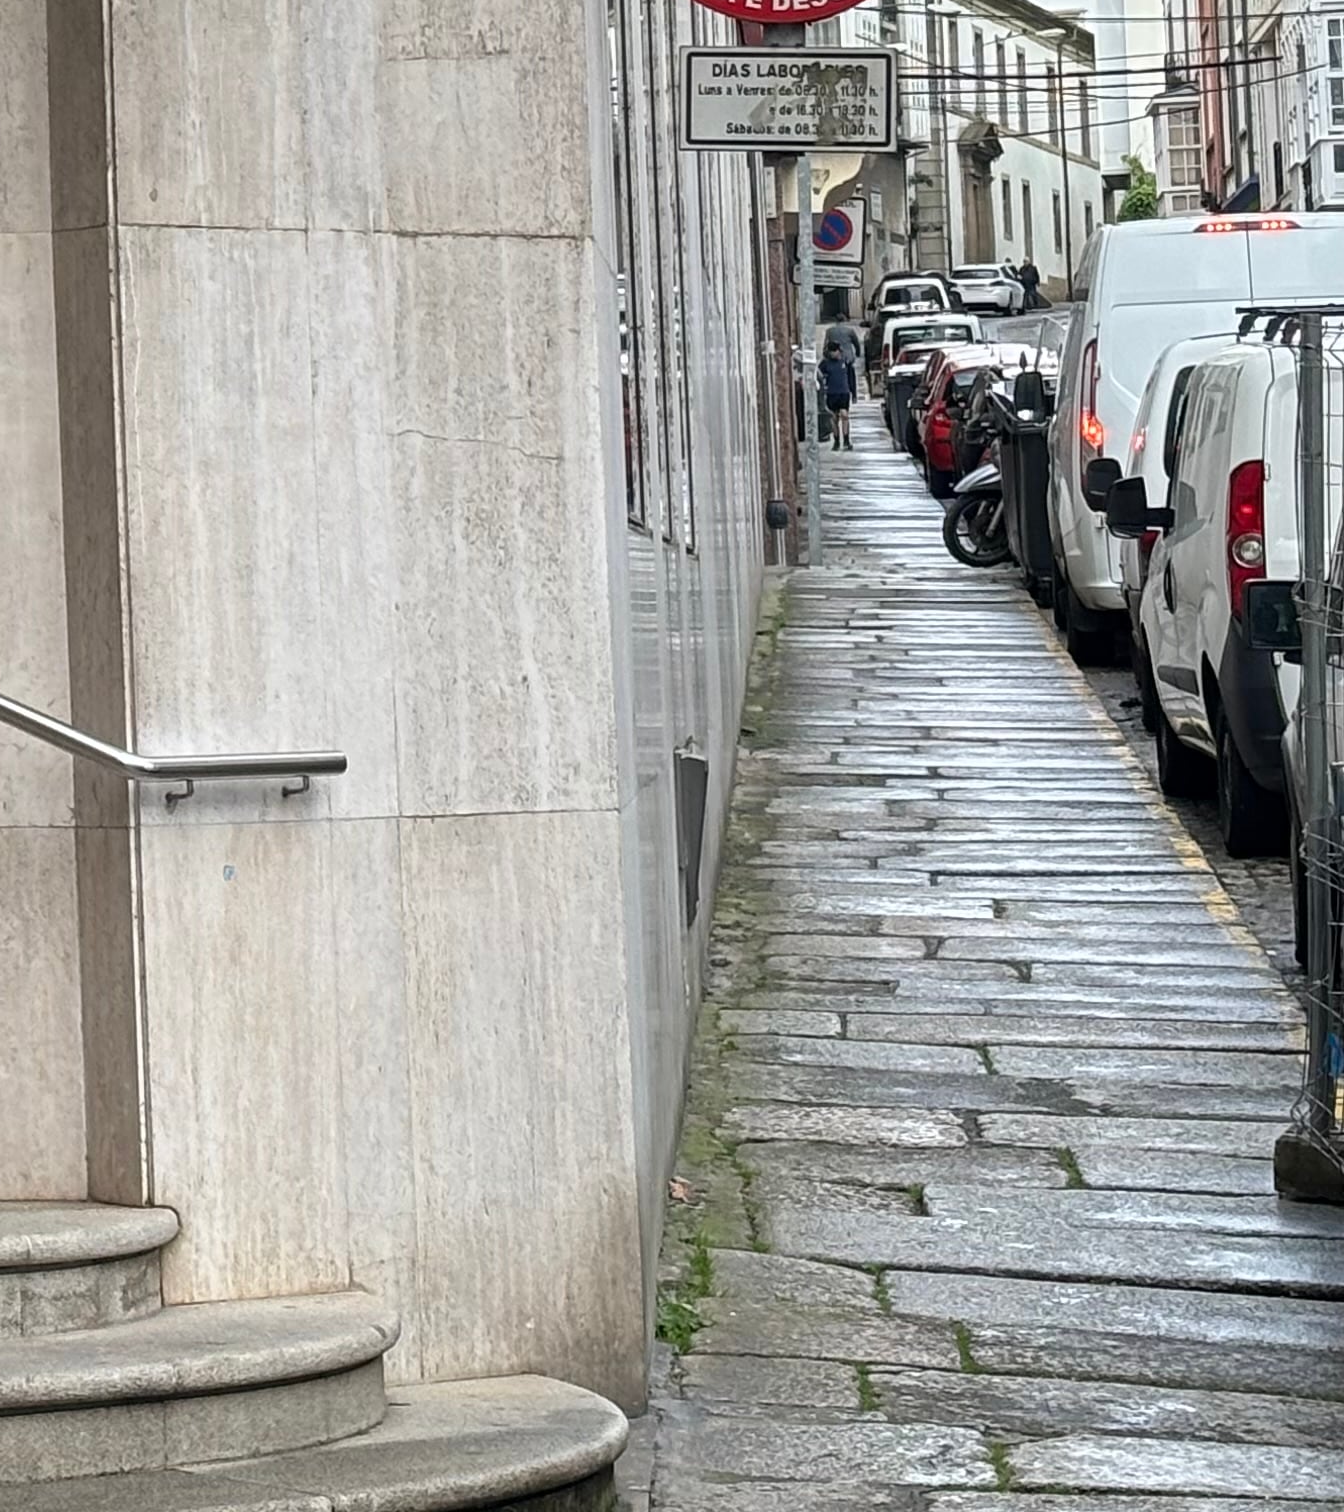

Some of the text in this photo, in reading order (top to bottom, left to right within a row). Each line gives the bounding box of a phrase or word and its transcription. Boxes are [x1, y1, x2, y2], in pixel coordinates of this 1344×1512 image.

[712, 59, 751, 78] DÍAS
[779, 104, 792, 116] de
[794, 123, 820, 136] 08.3
